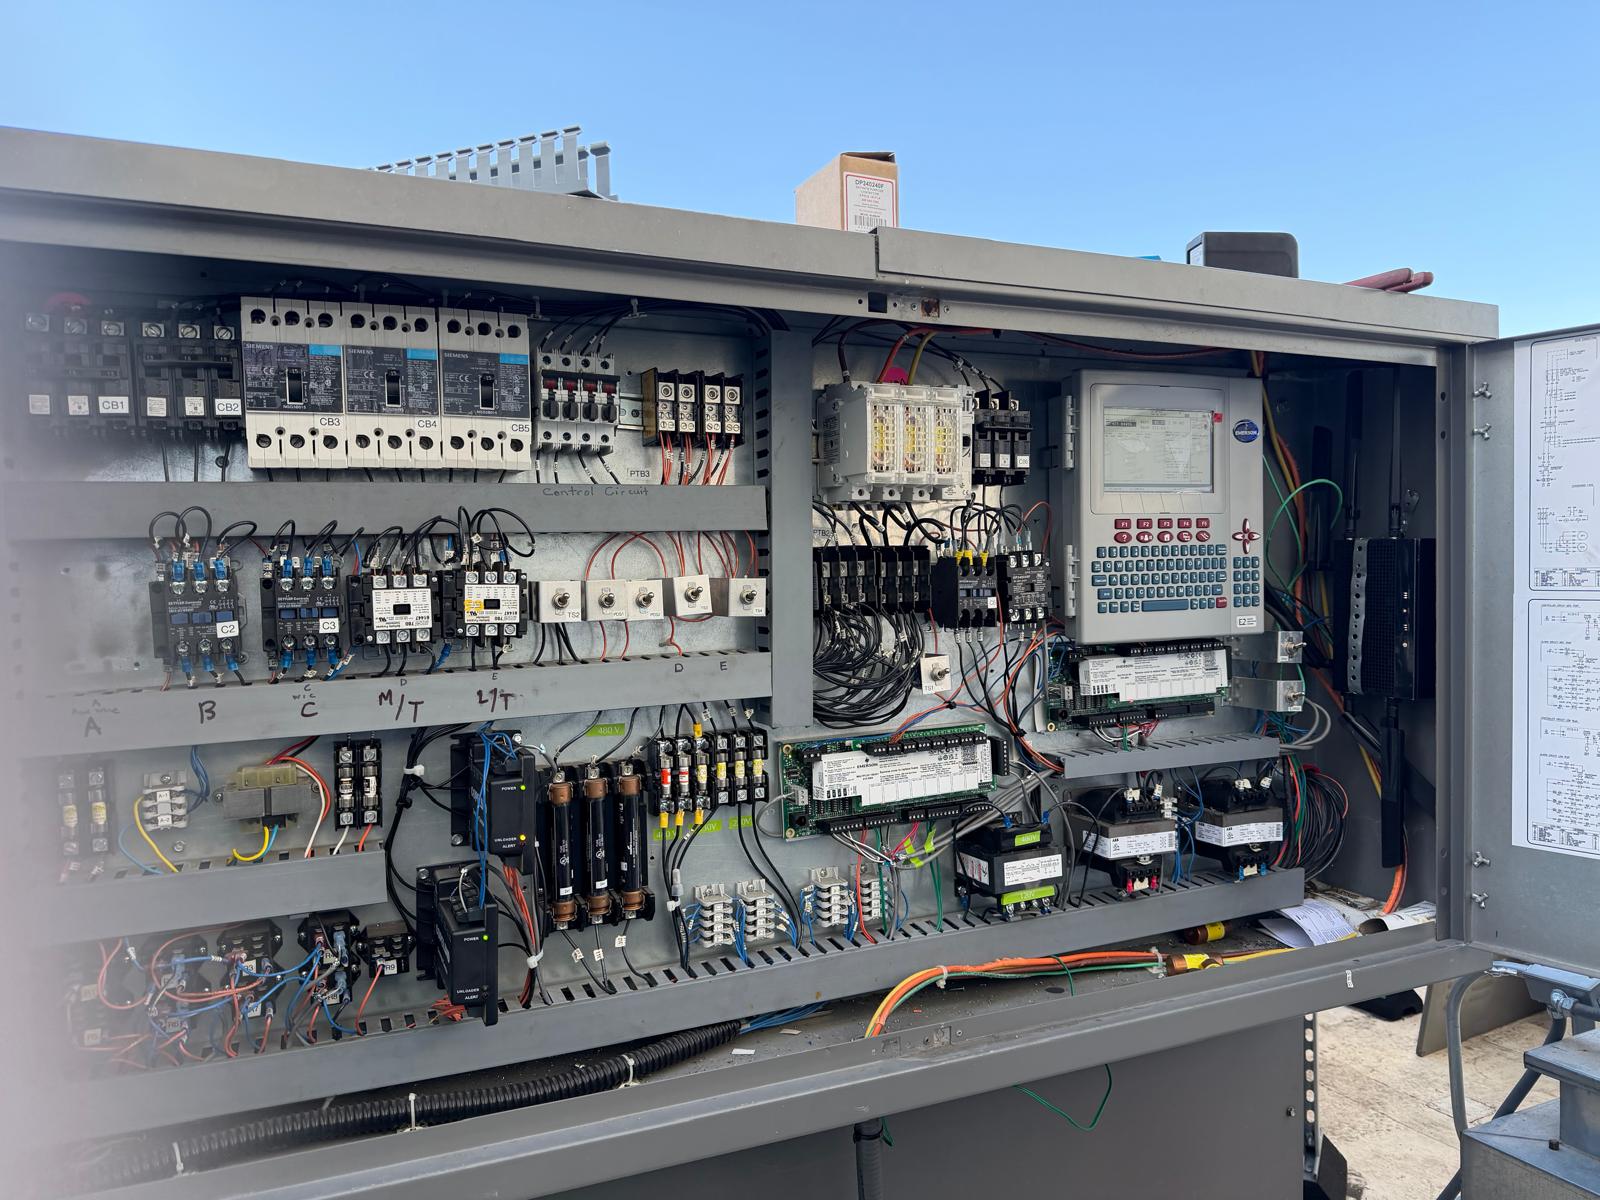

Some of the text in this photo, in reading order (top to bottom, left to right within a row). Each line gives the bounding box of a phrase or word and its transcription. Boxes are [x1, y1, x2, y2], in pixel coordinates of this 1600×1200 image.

[263, 367, 275, 375] CE
[363, 371, 375, 379] CE
[102, 401, 125, 410] CB1
[217, 402, 239, 411] CB2
[320, 417, 341, 427] CB3
[417, 420, 437, 428] CB4
[511, 424, 530, 432] CB5
[630, 470, 650, 478] PTB3
[542, 487, 649, 496] Control Circuit
[220, 625, 236, 634] C2
[322, 621, 336, 630] C3
[675, 661, 728, 673] D E
[491, 672, 498, 680] E
[400, 678, 407, 687] D
[304, 684, 311, 692] C
[198, 700, 216, 724] B
[300, 701, 319, 717] C
[84, 716, 101, 737] A
[598, 725, 621, 734] 480 V
